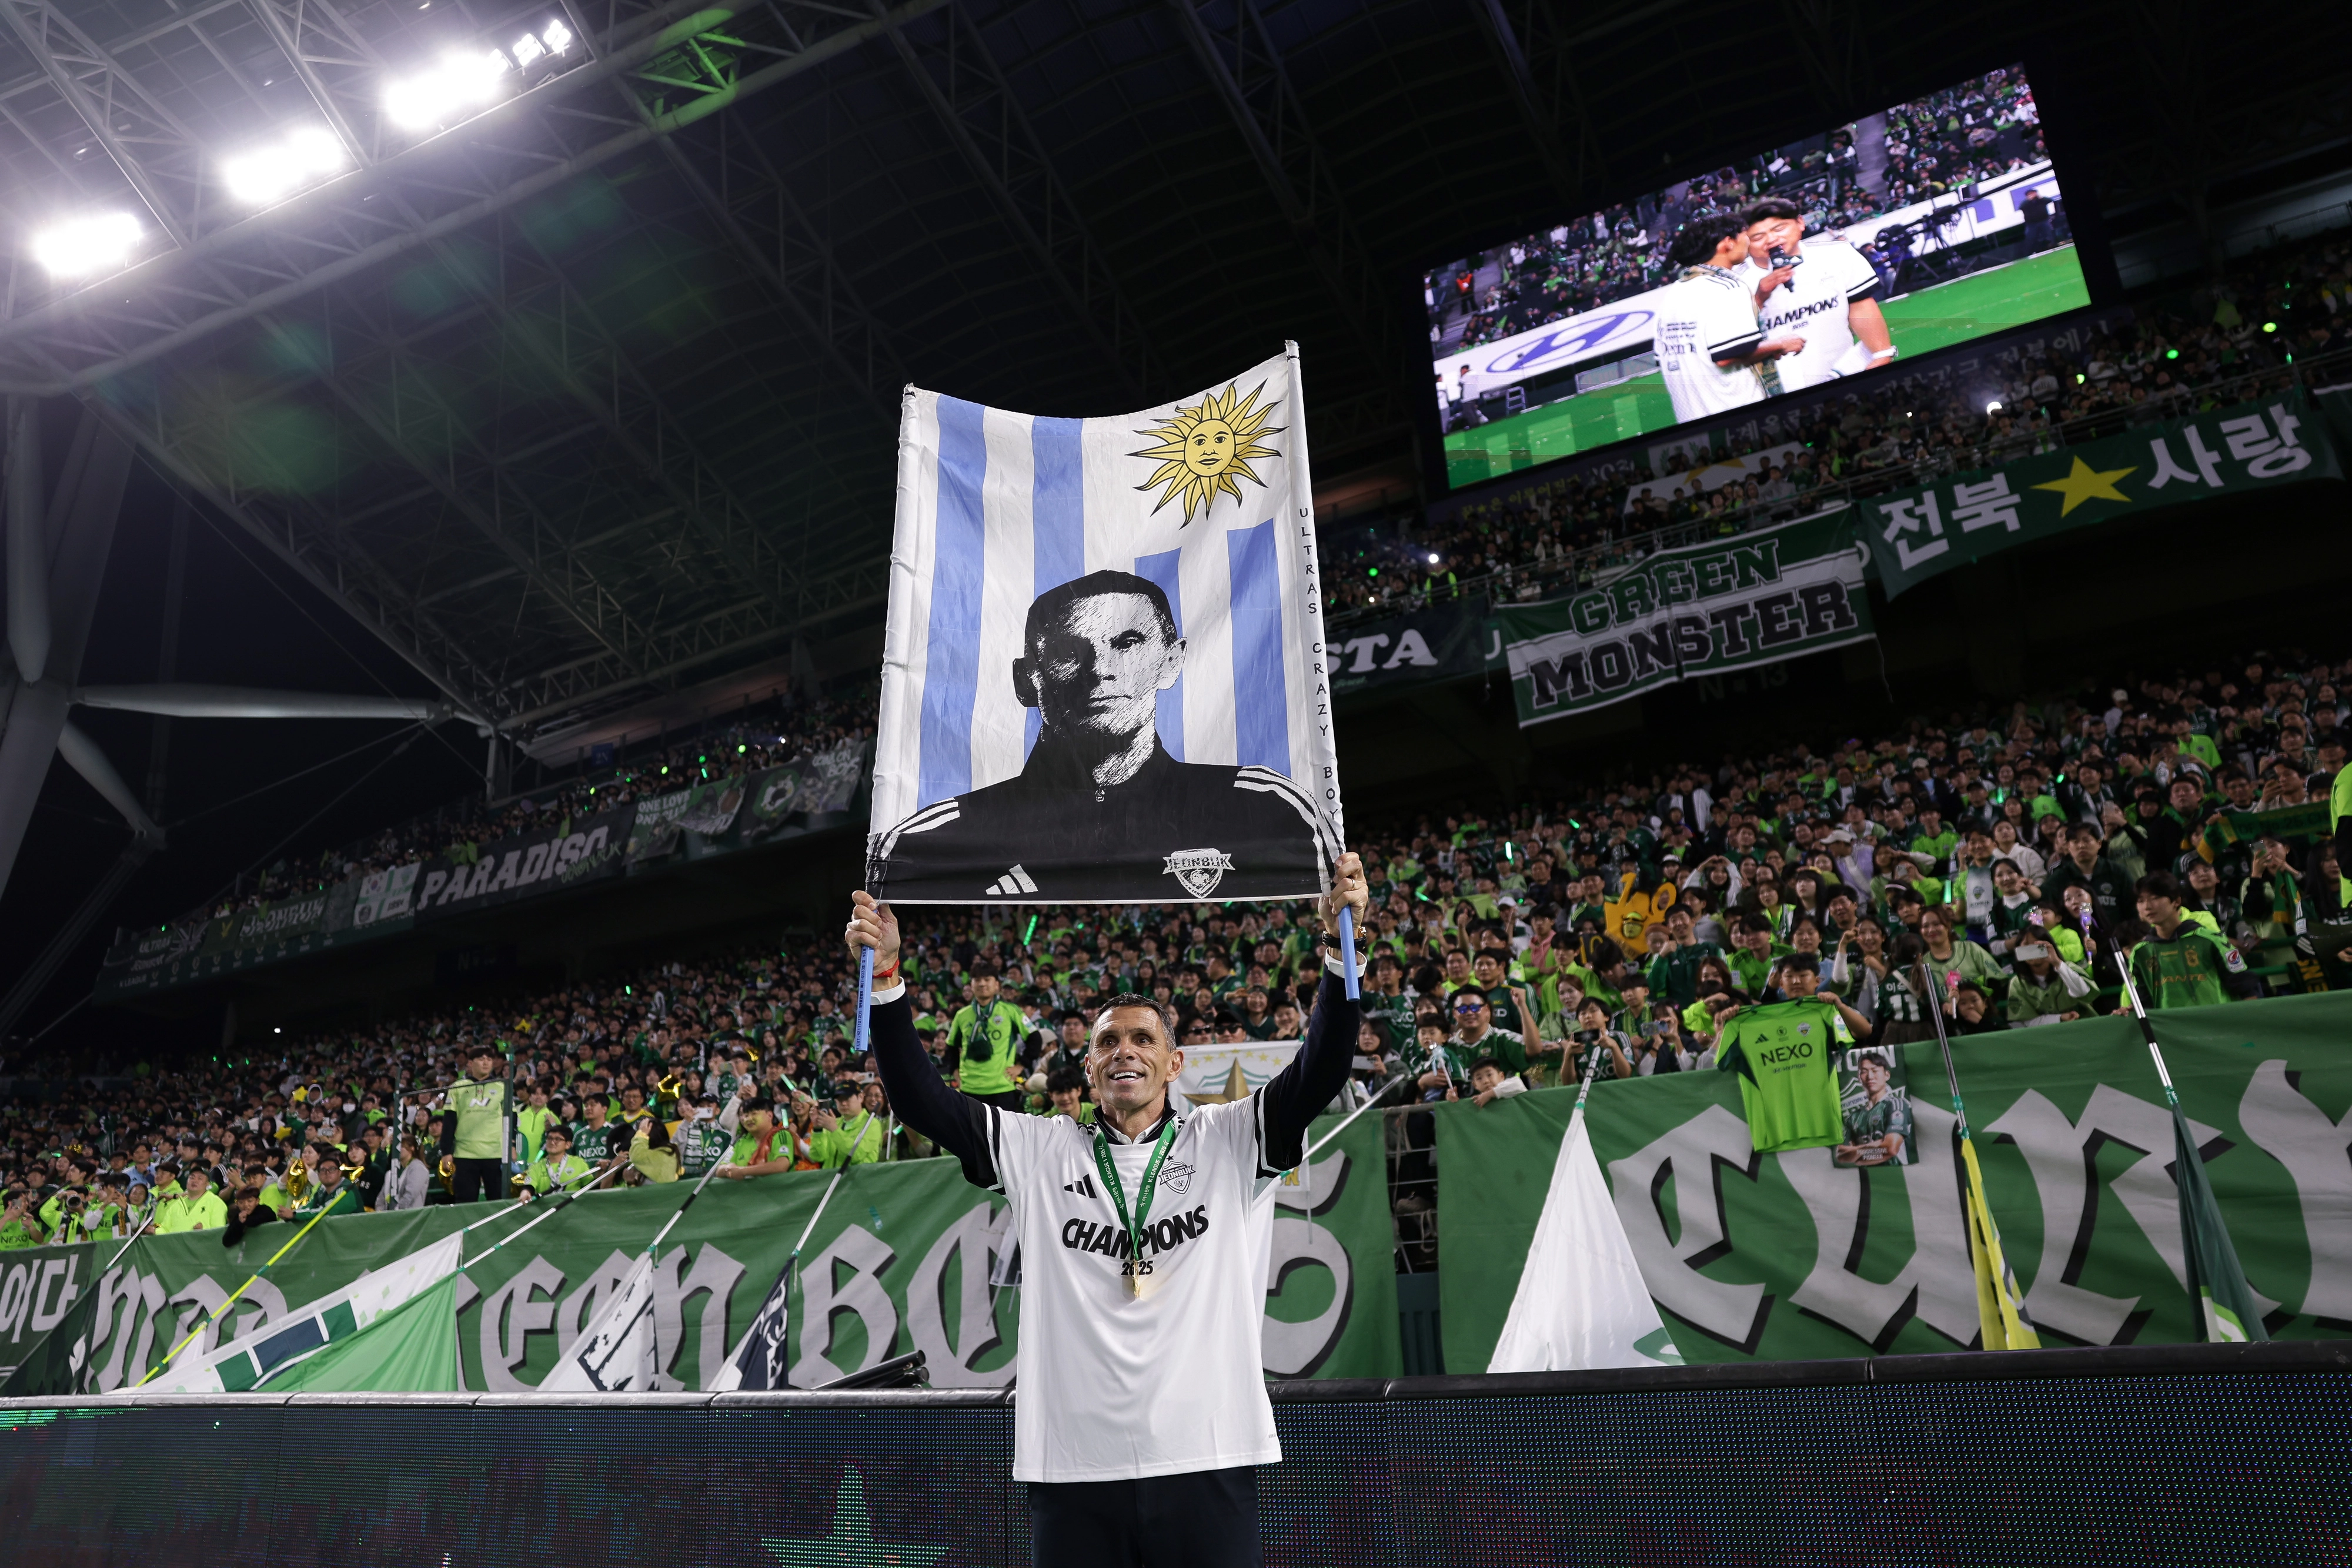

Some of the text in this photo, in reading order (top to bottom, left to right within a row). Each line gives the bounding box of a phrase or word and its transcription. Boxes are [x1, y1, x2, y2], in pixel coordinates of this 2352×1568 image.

[1763, 295, 1839, 330] HAMPIONS
[1879, 402, 2312, 571] 전북 사랑
[1569, 539, 1782, 637] GREEN
[1527, 576, 1858, 710] MONSTER
[1299, 507, 1338, 820] ULTRAS CRAZY BOY
[638, 789, 691, 813] ONE LOVE
[1168, 854, 1230, 871] JEONBUK
[1889, 994, 1921, 1022] 11
[1760, 1042, 1813, 1066] NEXO
[579, 1146, 607, 1158] NEXO
[705, 1146, 722, 1156] XO
[1150, 1158, 1161, 1179] LEAGUE
[1159, 1145, 1167, 1156] 2025
[1104, 1162, 1114, 1182] LEAGUE
[1160, 1166, 1194, 1184] JEONBUK
[1062, 1204, 1210, 1261] CHAMPIONS
